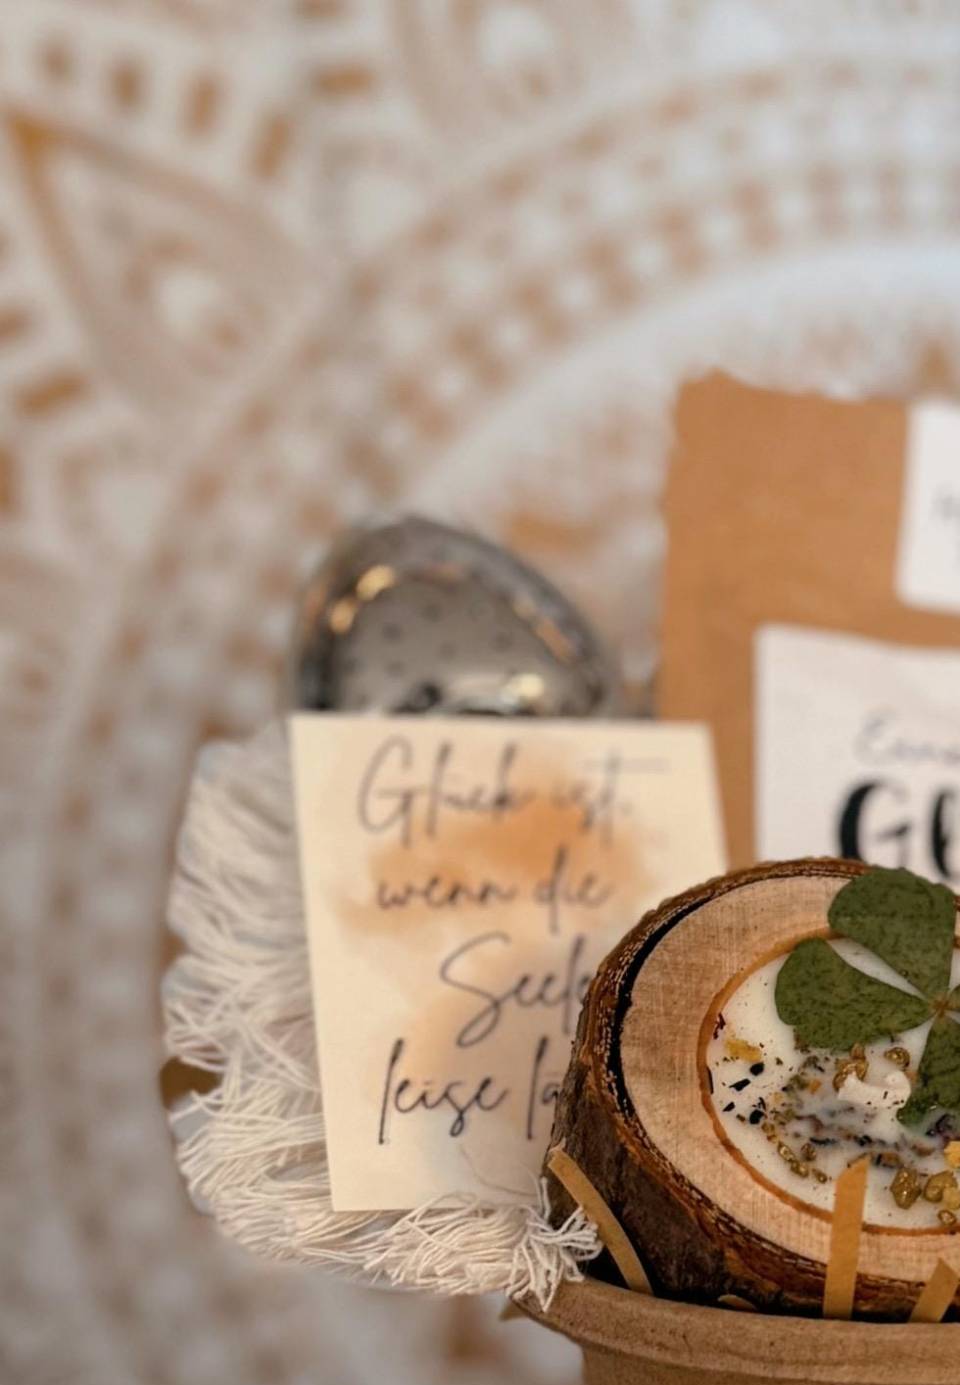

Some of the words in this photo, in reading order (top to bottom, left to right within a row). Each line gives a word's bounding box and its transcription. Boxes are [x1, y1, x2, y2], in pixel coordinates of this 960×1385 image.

[376, 873, 517, 911] wenn
[534, 844, 616, 935] die
[377, 1037, 508, 1144] leise
